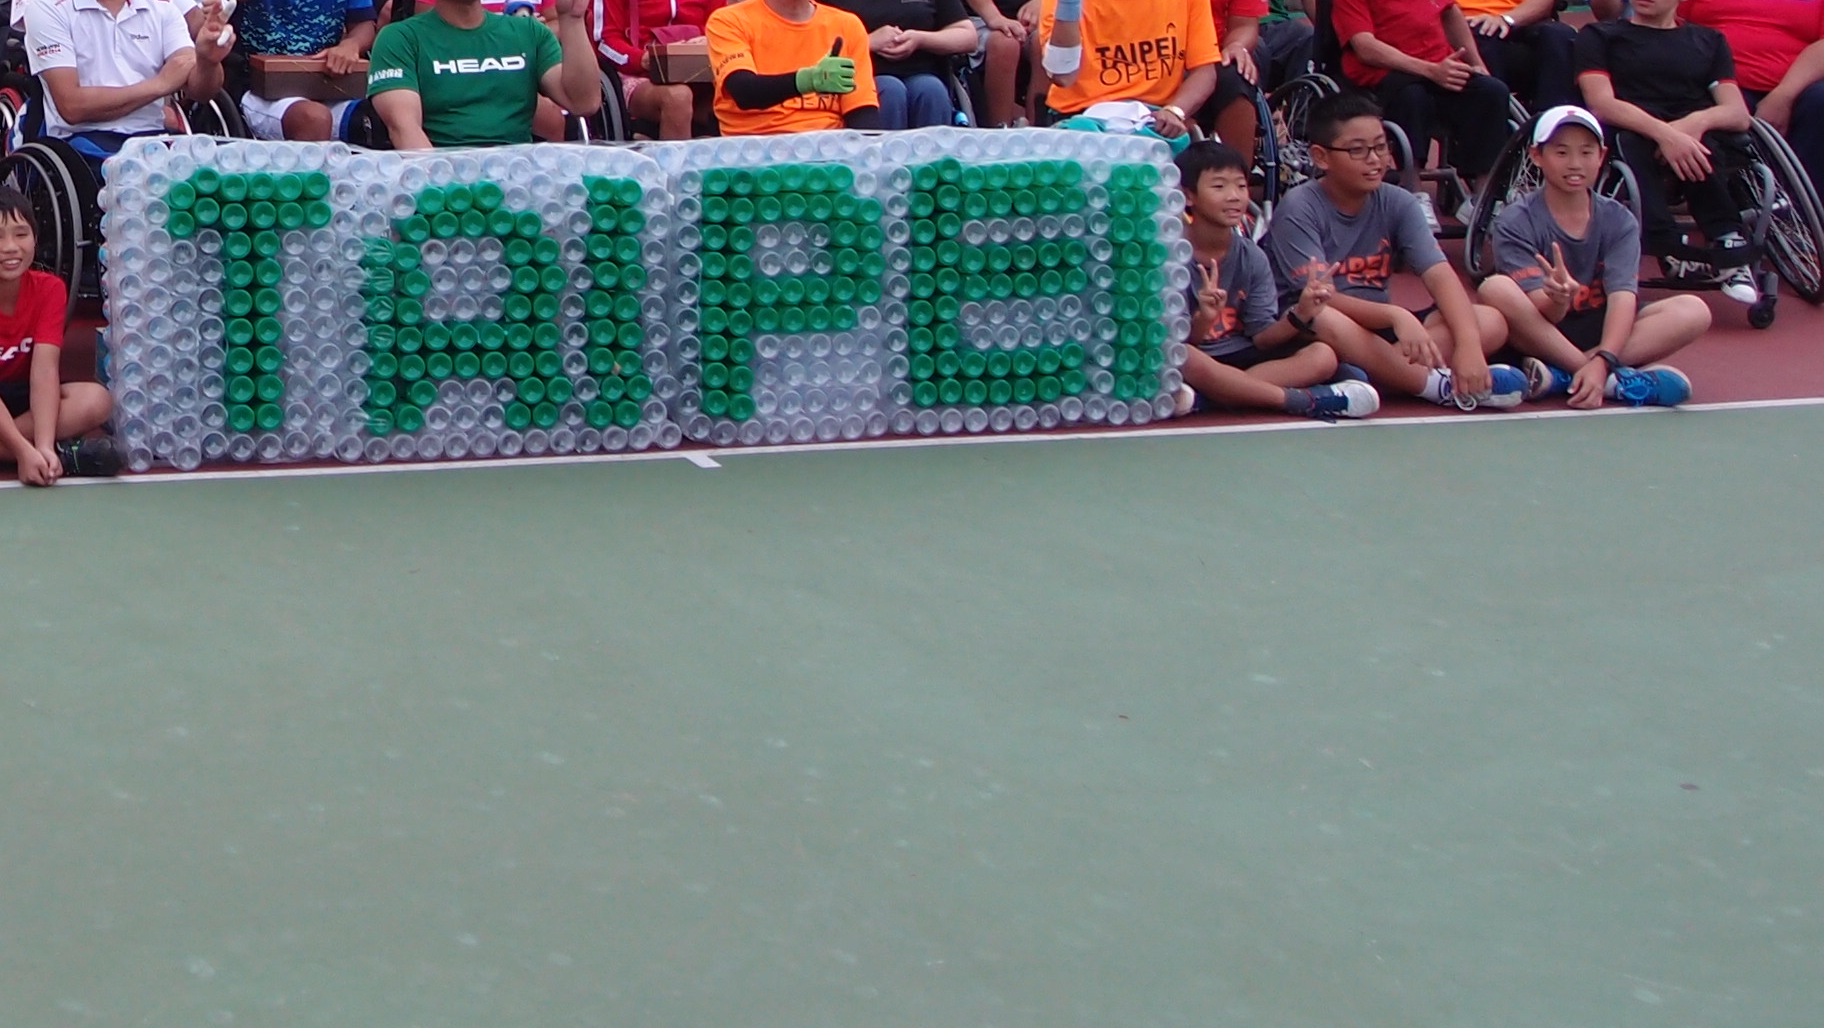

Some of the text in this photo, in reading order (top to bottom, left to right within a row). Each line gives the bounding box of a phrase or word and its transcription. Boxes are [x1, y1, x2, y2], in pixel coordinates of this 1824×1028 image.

[432, 55, 526, 74] HEAD
[1095, 36, 1177, 70] TAIPEI
[1099, 57, 1175, 87] OPEN
[164, 156, 1169, 436] TAIPEI
